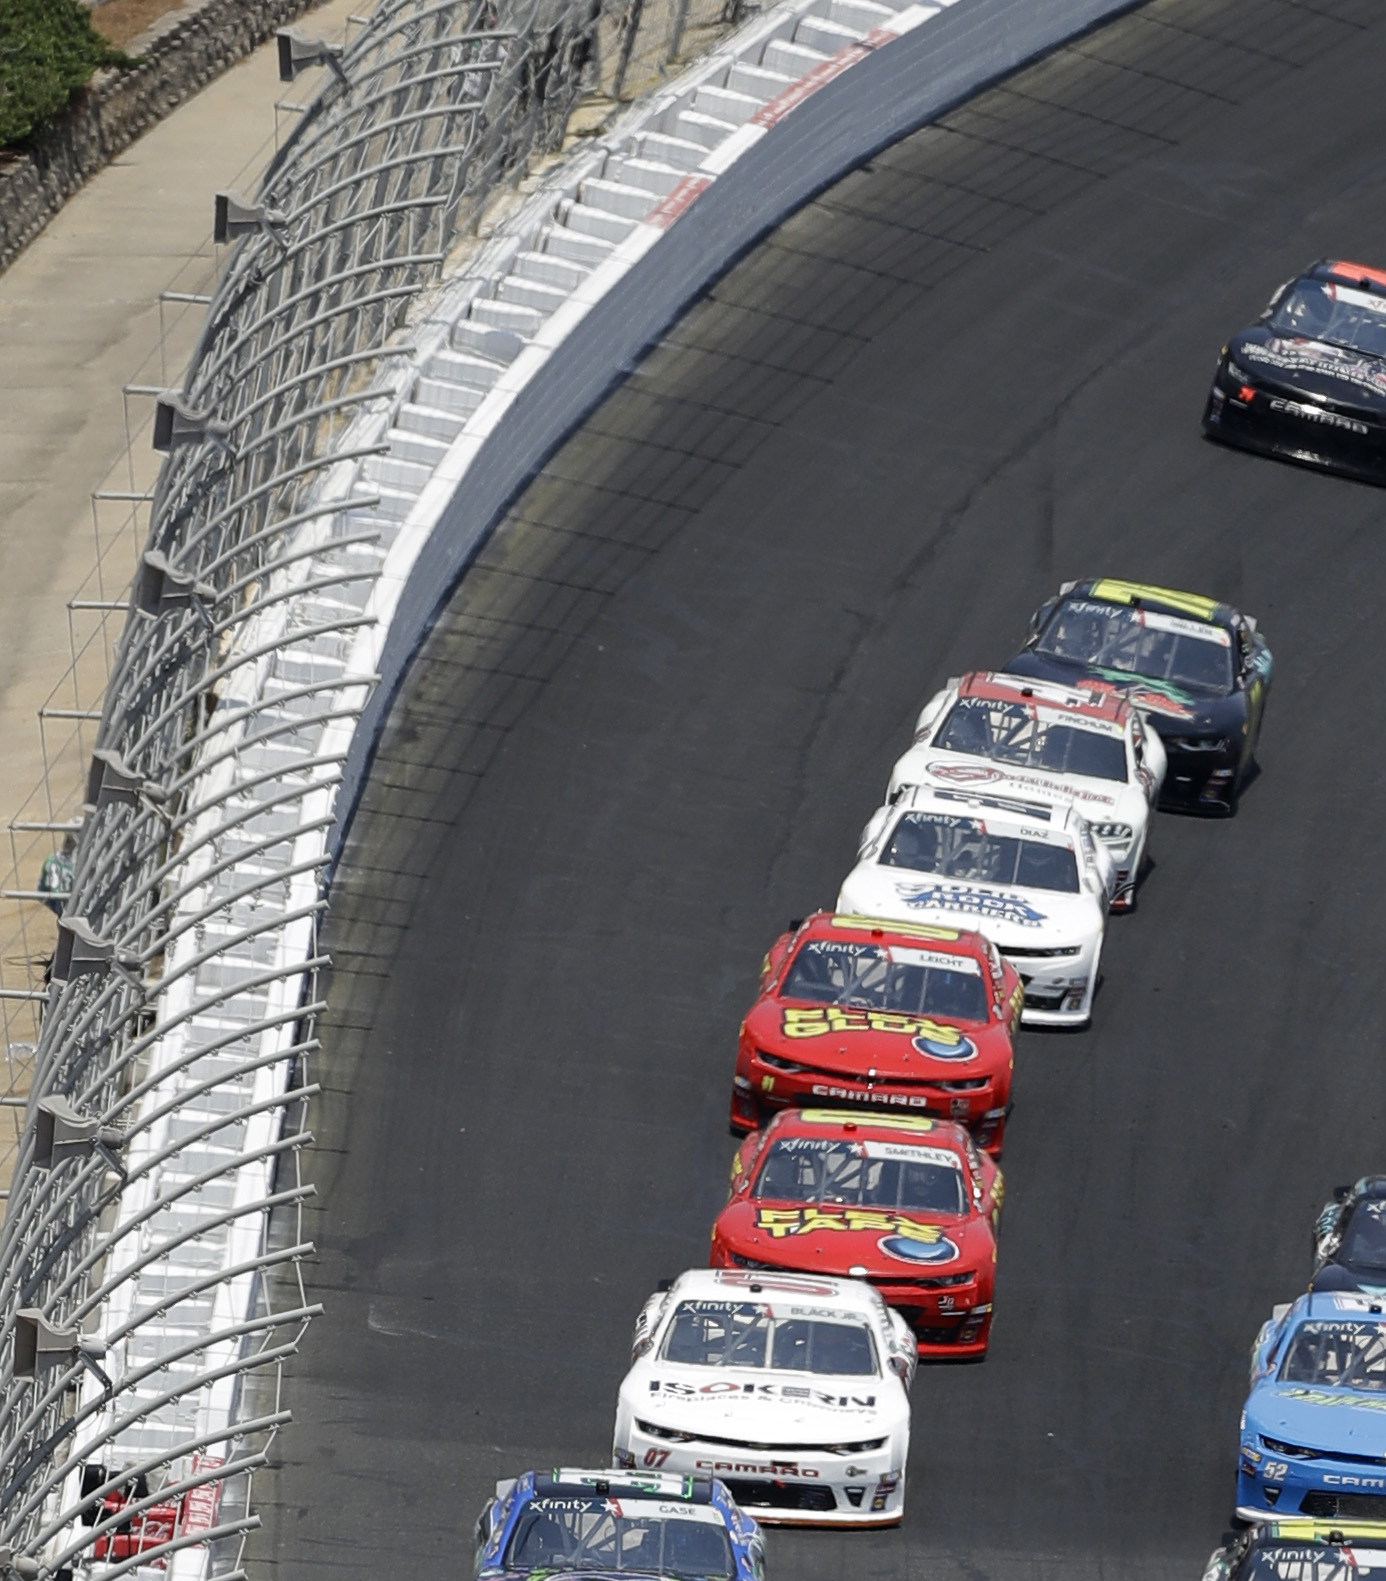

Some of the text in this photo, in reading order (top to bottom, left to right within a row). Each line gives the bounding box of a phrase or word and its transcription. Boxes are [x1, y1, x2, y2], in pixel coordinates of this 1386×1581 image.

[904, 812, 961, 827] xfinity
[1020, 828, 1050, 840] DIAZ
[807, 942, 866, 957] xfinity
[919, 954, 964, 967] LEICHT
[812, 1084, 927, 1107] CAMARO
[779, 1139, 840, 1153] xfinity
[682, 1301, 744, 1313] xfinity
[790, 1308, 839, 1319] BLACK
[1303, 1322, 1366, 1335] xfinity
[649, 1381, 876, 1408] ISOKERN
[643, 1448, 672, 1467] 07
[696, 1460, 819, 1477] CAMARO
[1263, 1462, 1288, 1481] 52
[529, 1499, 593, 1513] xfinity
[1261, 1548, 1326, 1564] xfinity
